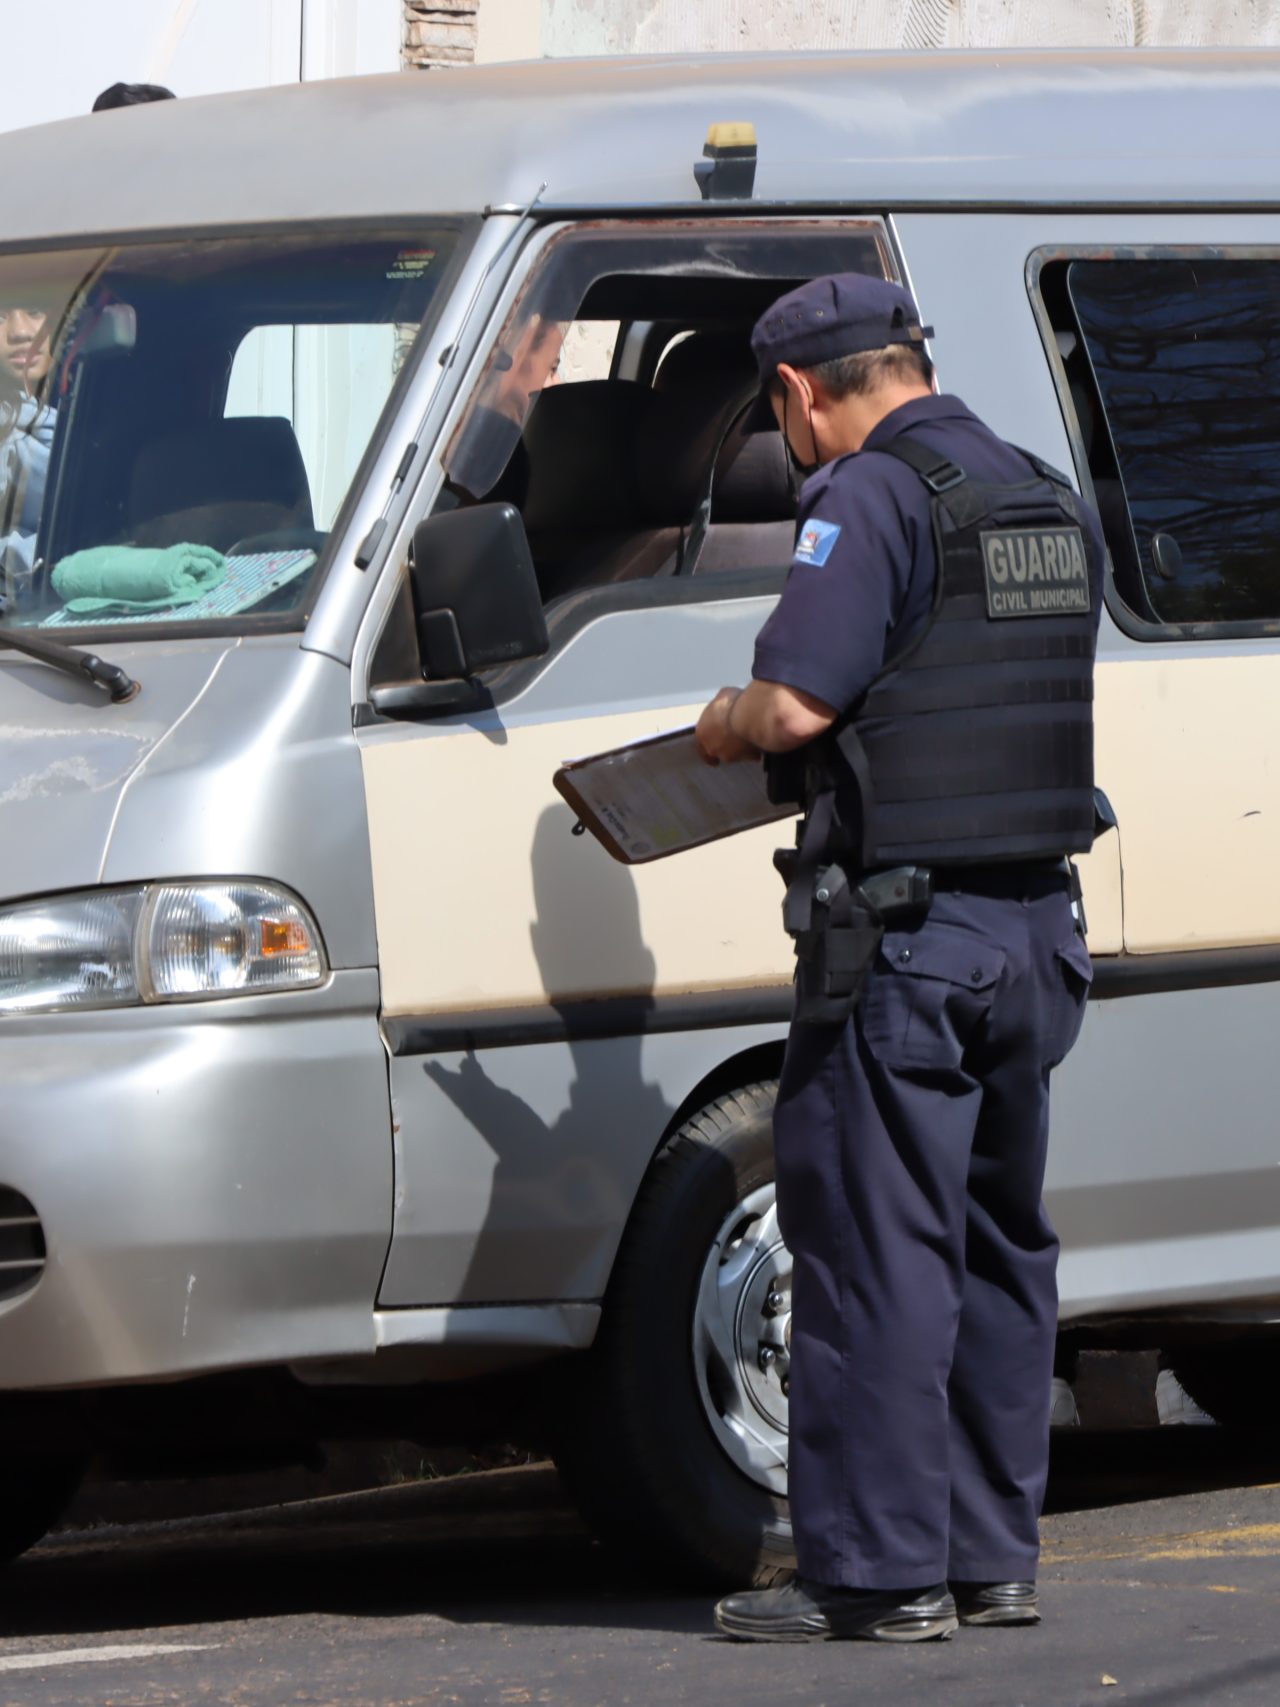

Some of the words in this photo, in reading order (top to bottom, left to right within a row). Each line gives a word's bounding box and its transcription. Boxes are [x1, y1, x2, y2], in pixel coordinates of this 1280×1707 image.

[987, 533, 1085, 583] GUARDA
[993, 591, 1028, 611] CIVIL
[1030, 588, 1087, 609] MUNICIPAL
